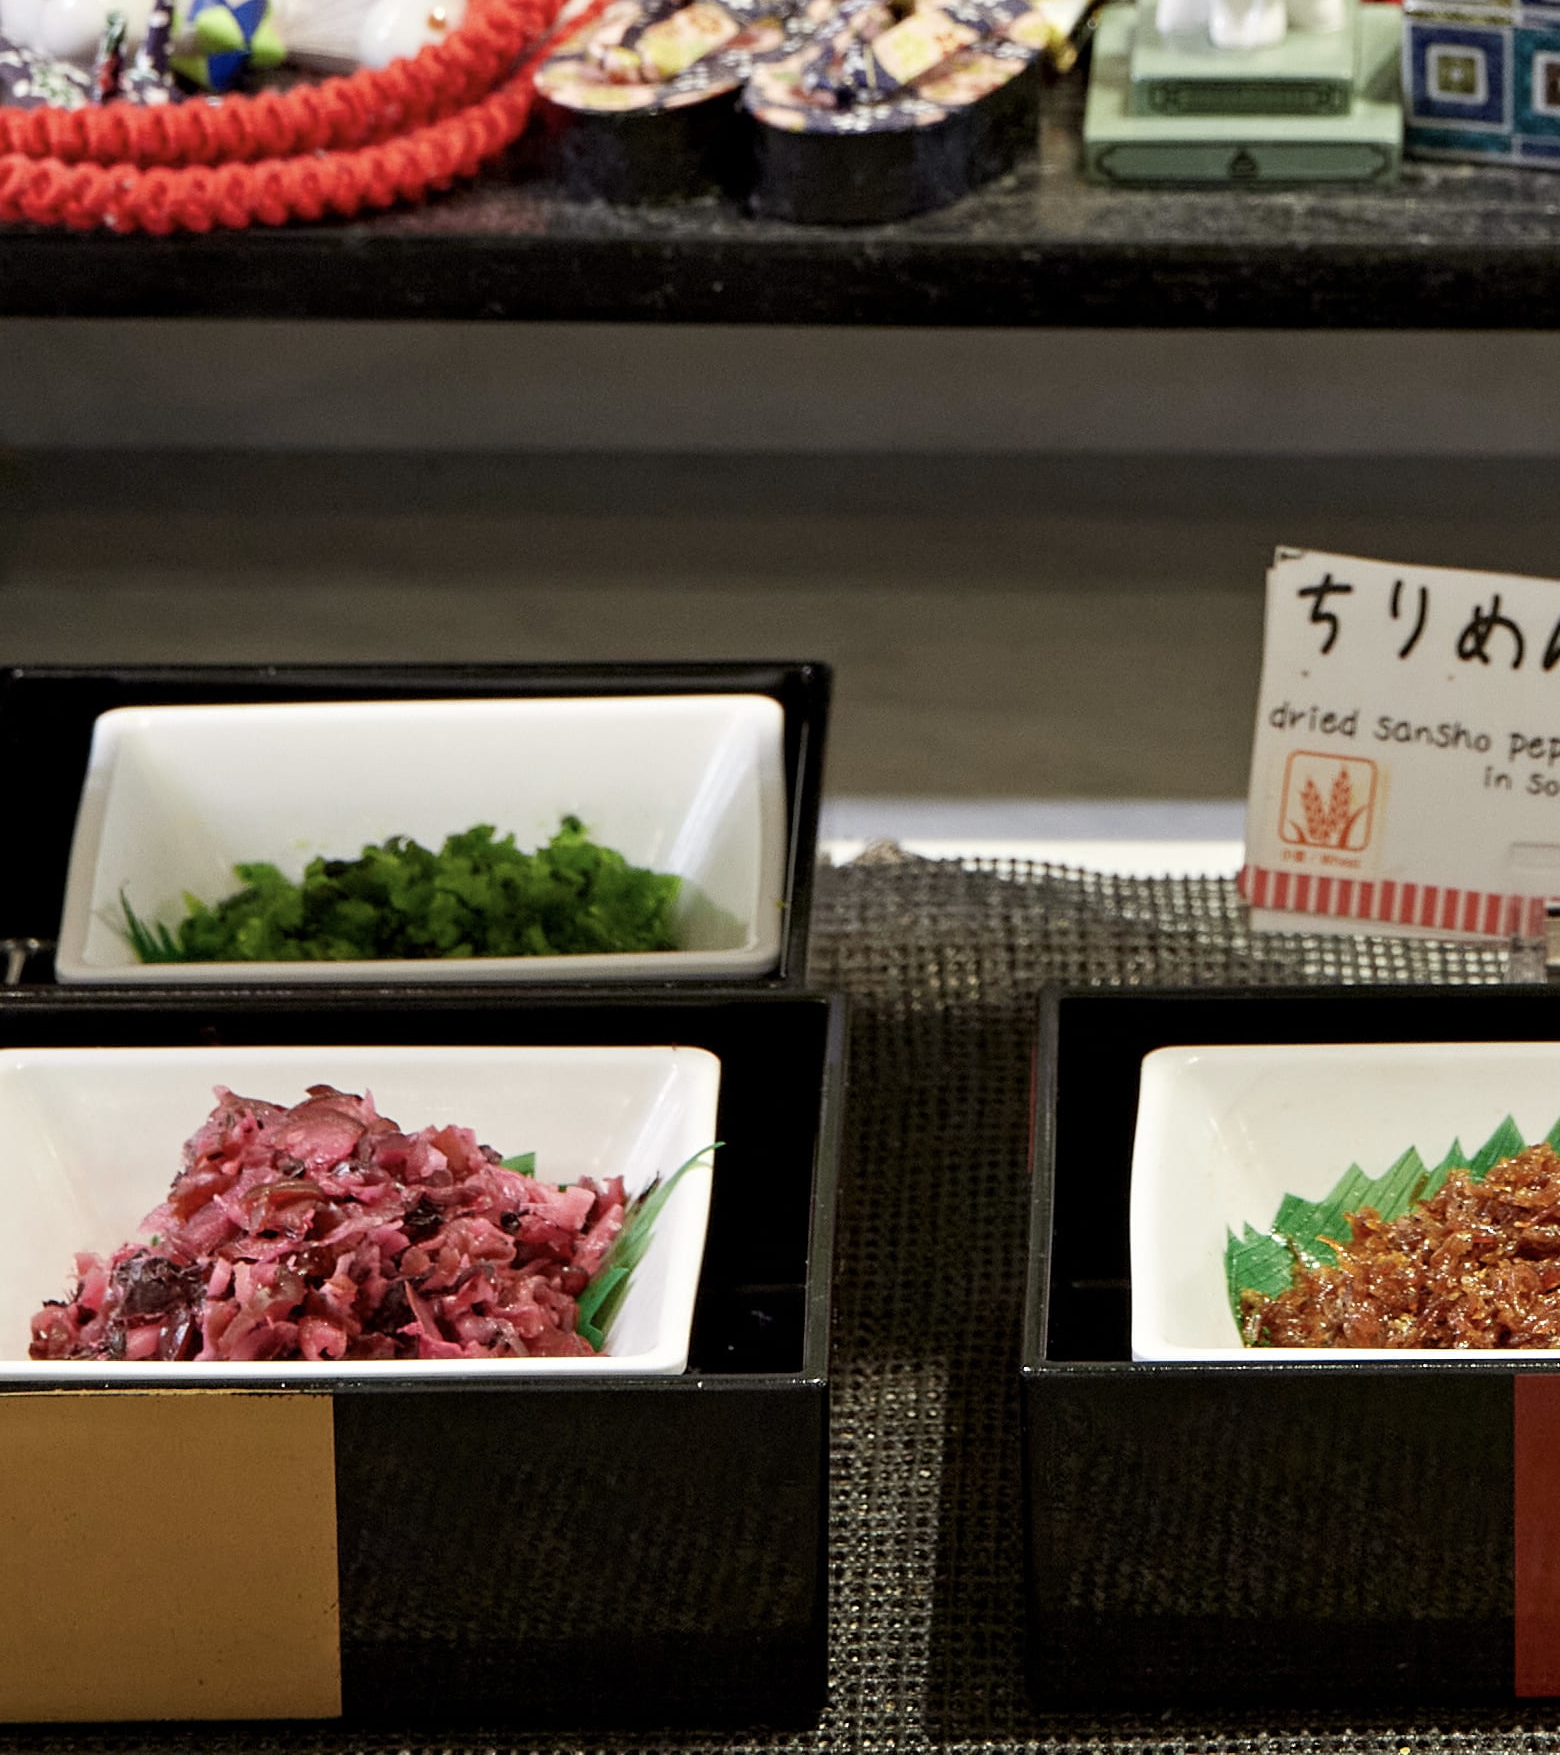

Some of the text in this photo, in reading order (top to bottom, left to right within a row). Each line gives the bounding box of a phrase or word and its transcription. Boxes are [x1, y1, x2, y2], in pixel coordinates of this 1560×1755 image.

[1268, 700, 1360, 739] dried
[1373, 715, 1493, 754] sansho
[1484, 765, 1513, 791] in
